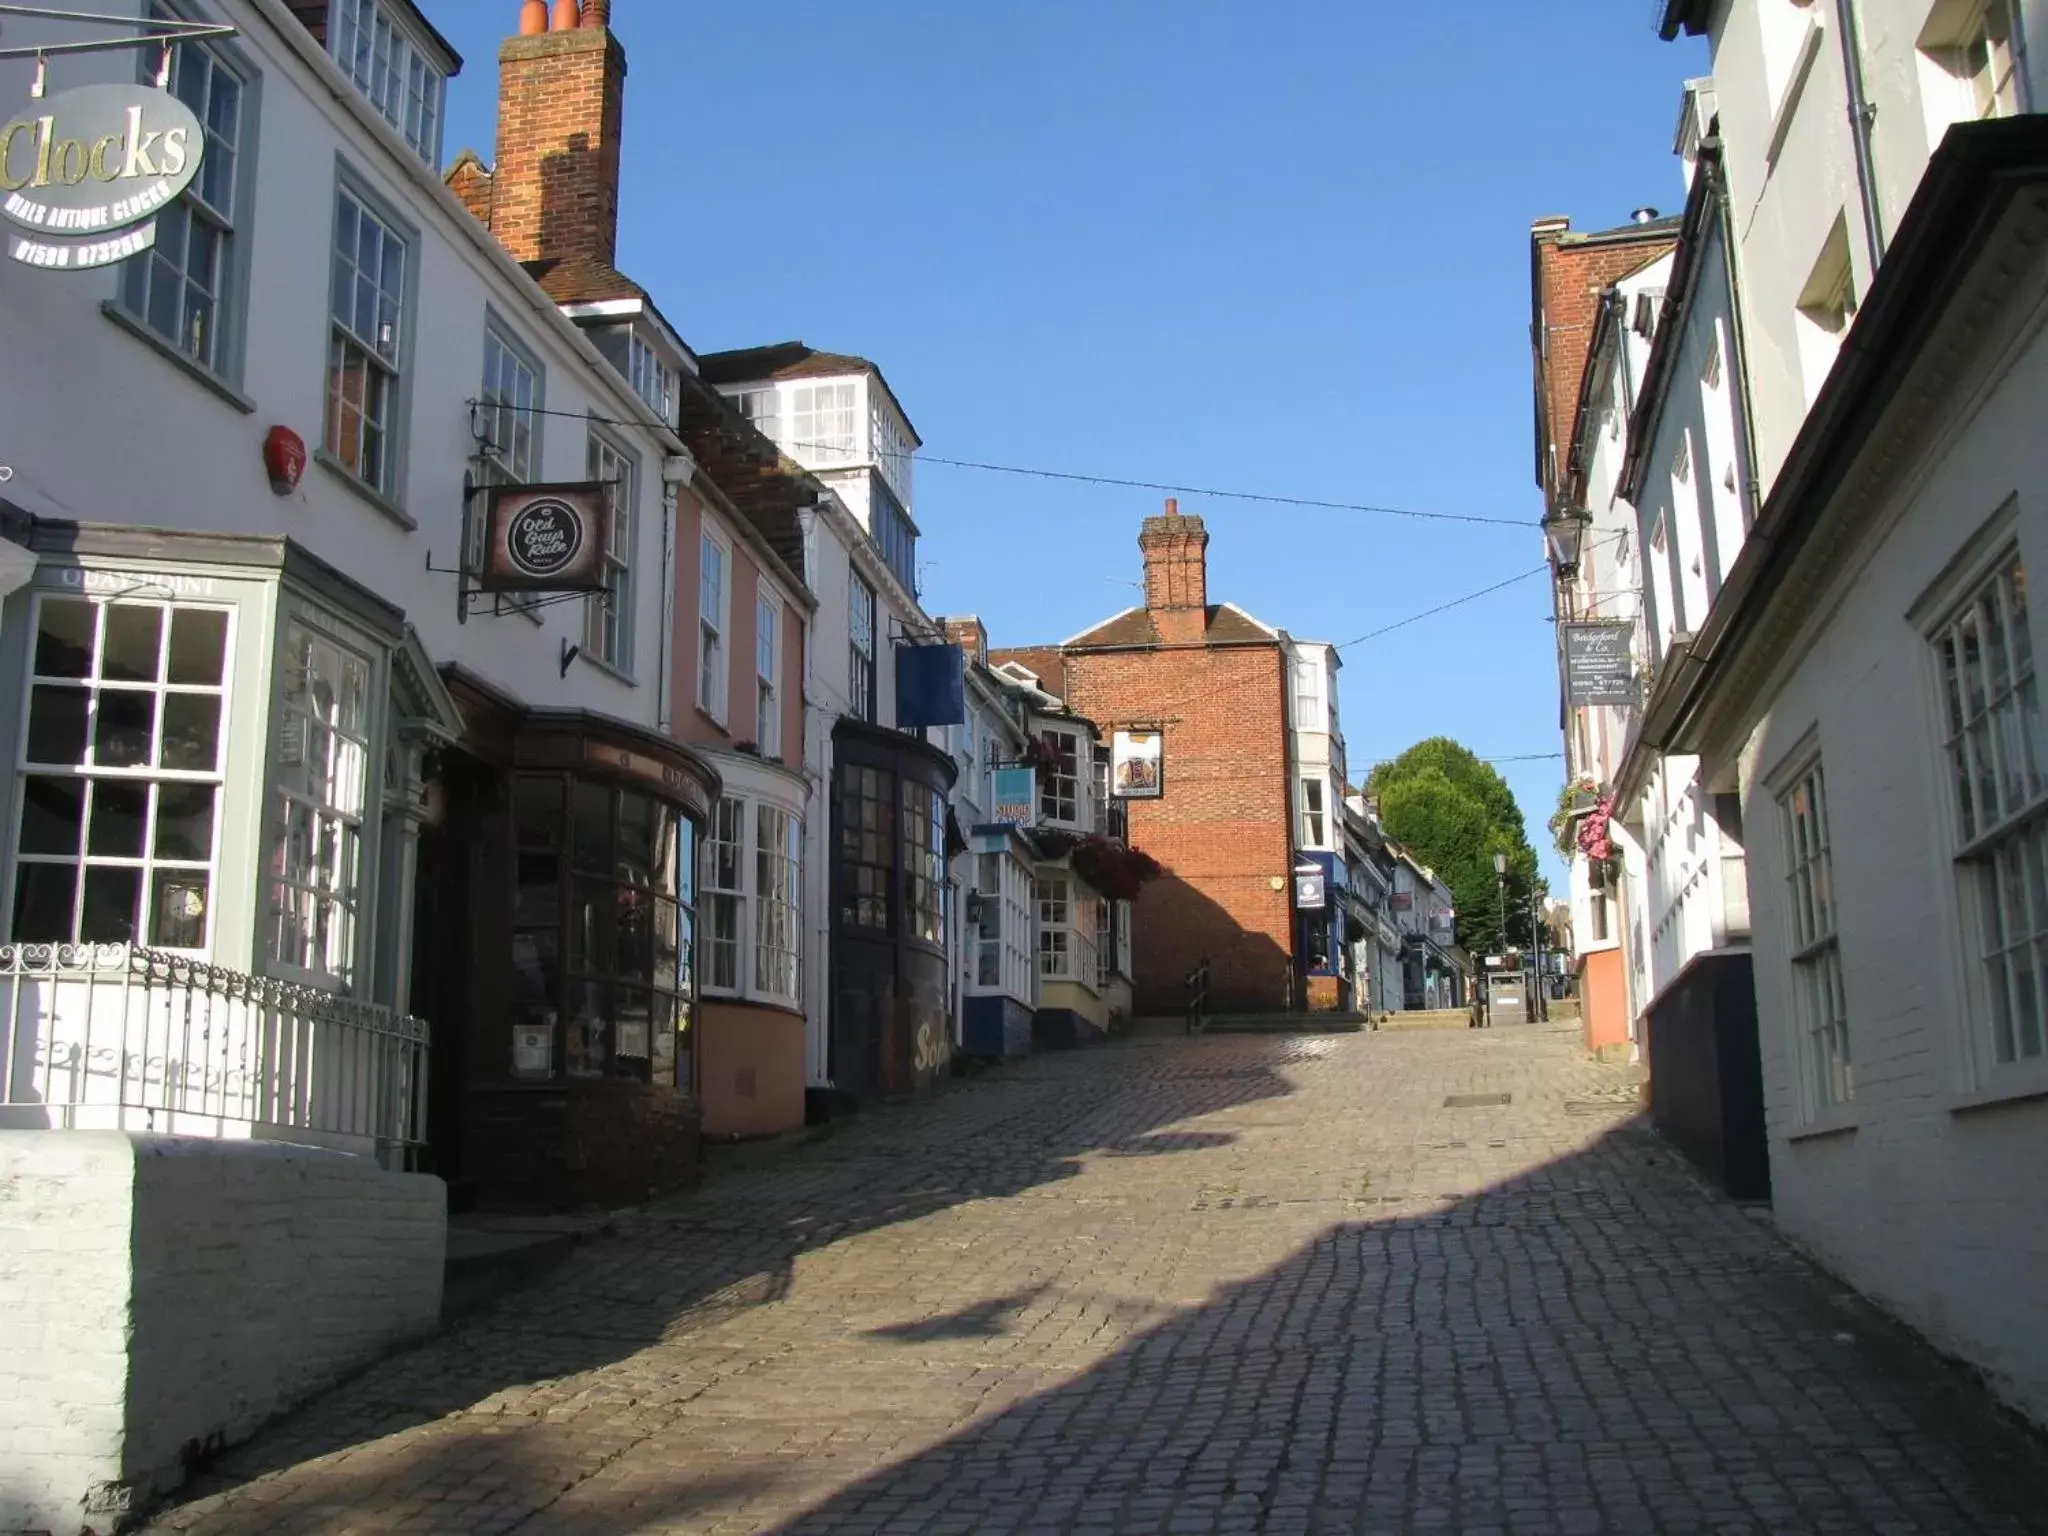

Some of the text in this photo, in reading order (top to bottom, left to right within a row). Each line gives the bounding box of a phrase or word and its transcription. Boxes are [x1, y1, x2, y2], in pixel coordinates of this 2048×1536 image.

[0, 104, 188, 191] Clocks
[5, 180, 171, 230] DIALS ANTIQUE CLOCKS
[523, 517, 556, 532] Old
[524, 529, 565, 546] Guys
[527, 541, 568, 558] Rule
[144, 572, 219, 595] POINT
